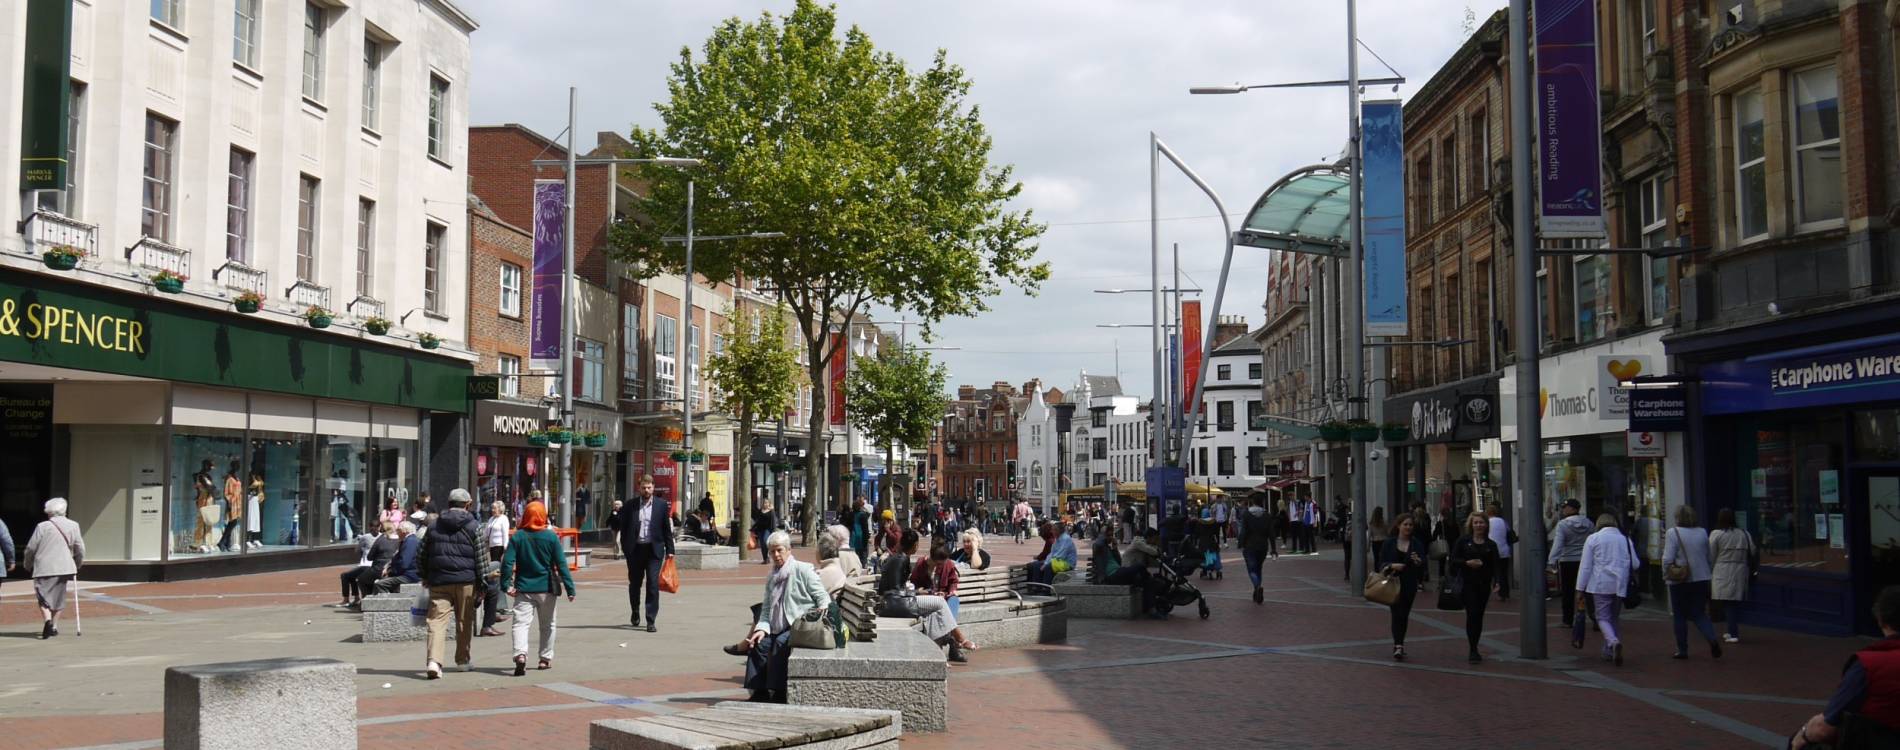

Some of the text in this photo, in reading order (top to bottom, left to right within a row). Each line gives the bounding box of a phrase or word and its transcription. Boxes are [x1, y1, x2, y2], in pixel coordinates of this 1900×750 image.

[1546, 83, 1560, 181] ambitious Reading
[0, 298, 144, 353] & SPENCER
[1778, 361, 1853, 388] Carphone
[469, 382, 496, 394] M&S
[1549, 387, 1597, 417] Thomas C
[1638, 399, 1685, 409] Carphone
[5, 408, 45, 420] Change
[1633, 409, 1685, 417] Warehouse
[493, 415, 539, 434] MONSOON
